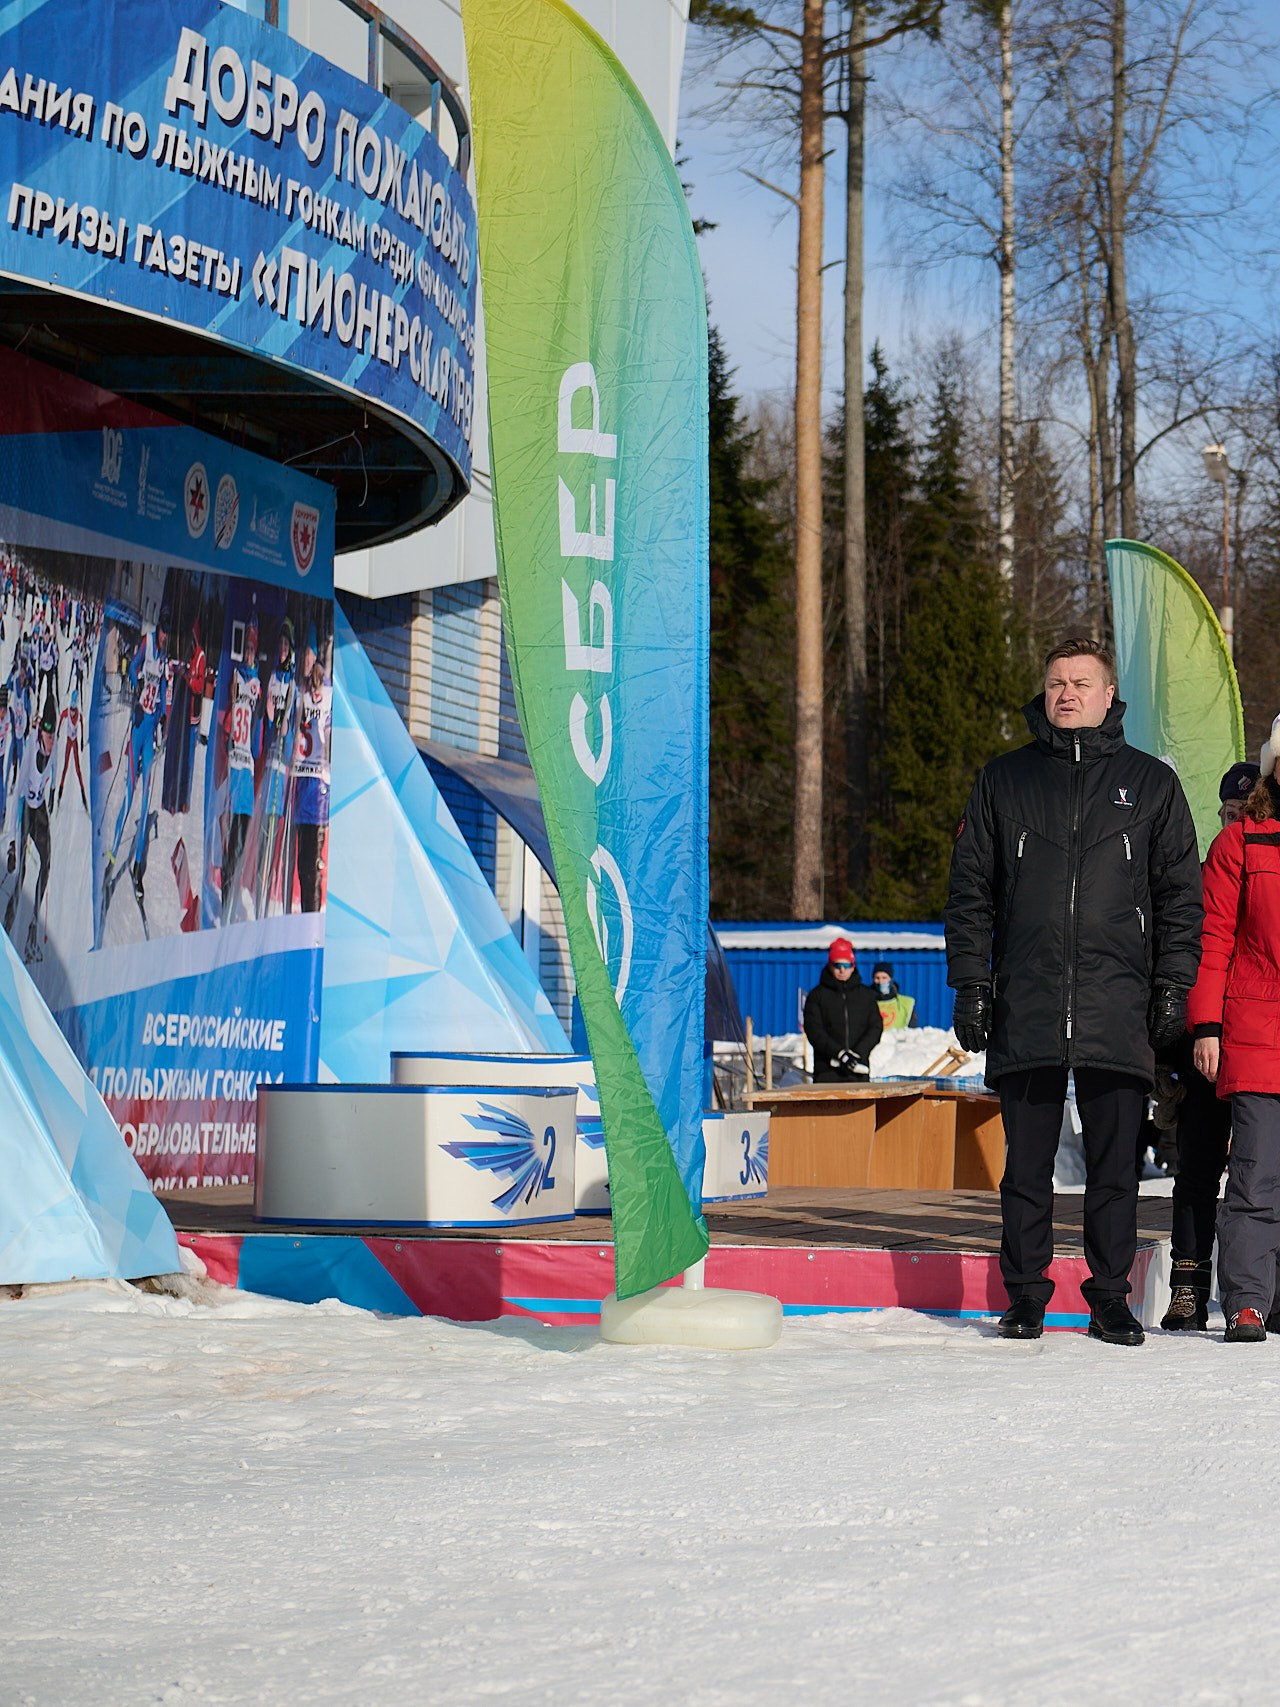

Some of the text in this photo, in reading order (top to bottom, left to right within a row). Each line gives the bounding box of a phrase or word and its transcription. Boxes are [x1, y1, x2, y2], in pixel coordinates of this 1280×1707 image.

[164, 26, 470, 284] ДОБРО ПОЖАЛОВАТЬ
[100, 100, 147, 153] ПО
[152, 123, 281, 210] ЛЫЖНЫМ
[285, 178, 366, 251] ГОНКАМ
[370, 222, 415, 283] СРЕДИ
[6, 182, 127, 257] ПРИЗЫ
[133, 223, 240, 296] ГАЗЕТЫ
[251, 246, 450, 411] «ПИОНЕРСКАЯ
[557, 360, 618, 788] СБЕР
[233, 706, 250, 746] 35
[142, 1006, 287, 1052] ВСЕРОССИЙСКИЕ
[101, 1066, 127, 1100] ПО
[128, 1066, 209, 1101] ЛЫЖНЫМ
[541, 1125, 556, 1191] 2
[739, 1129, 752, 1187] 3
